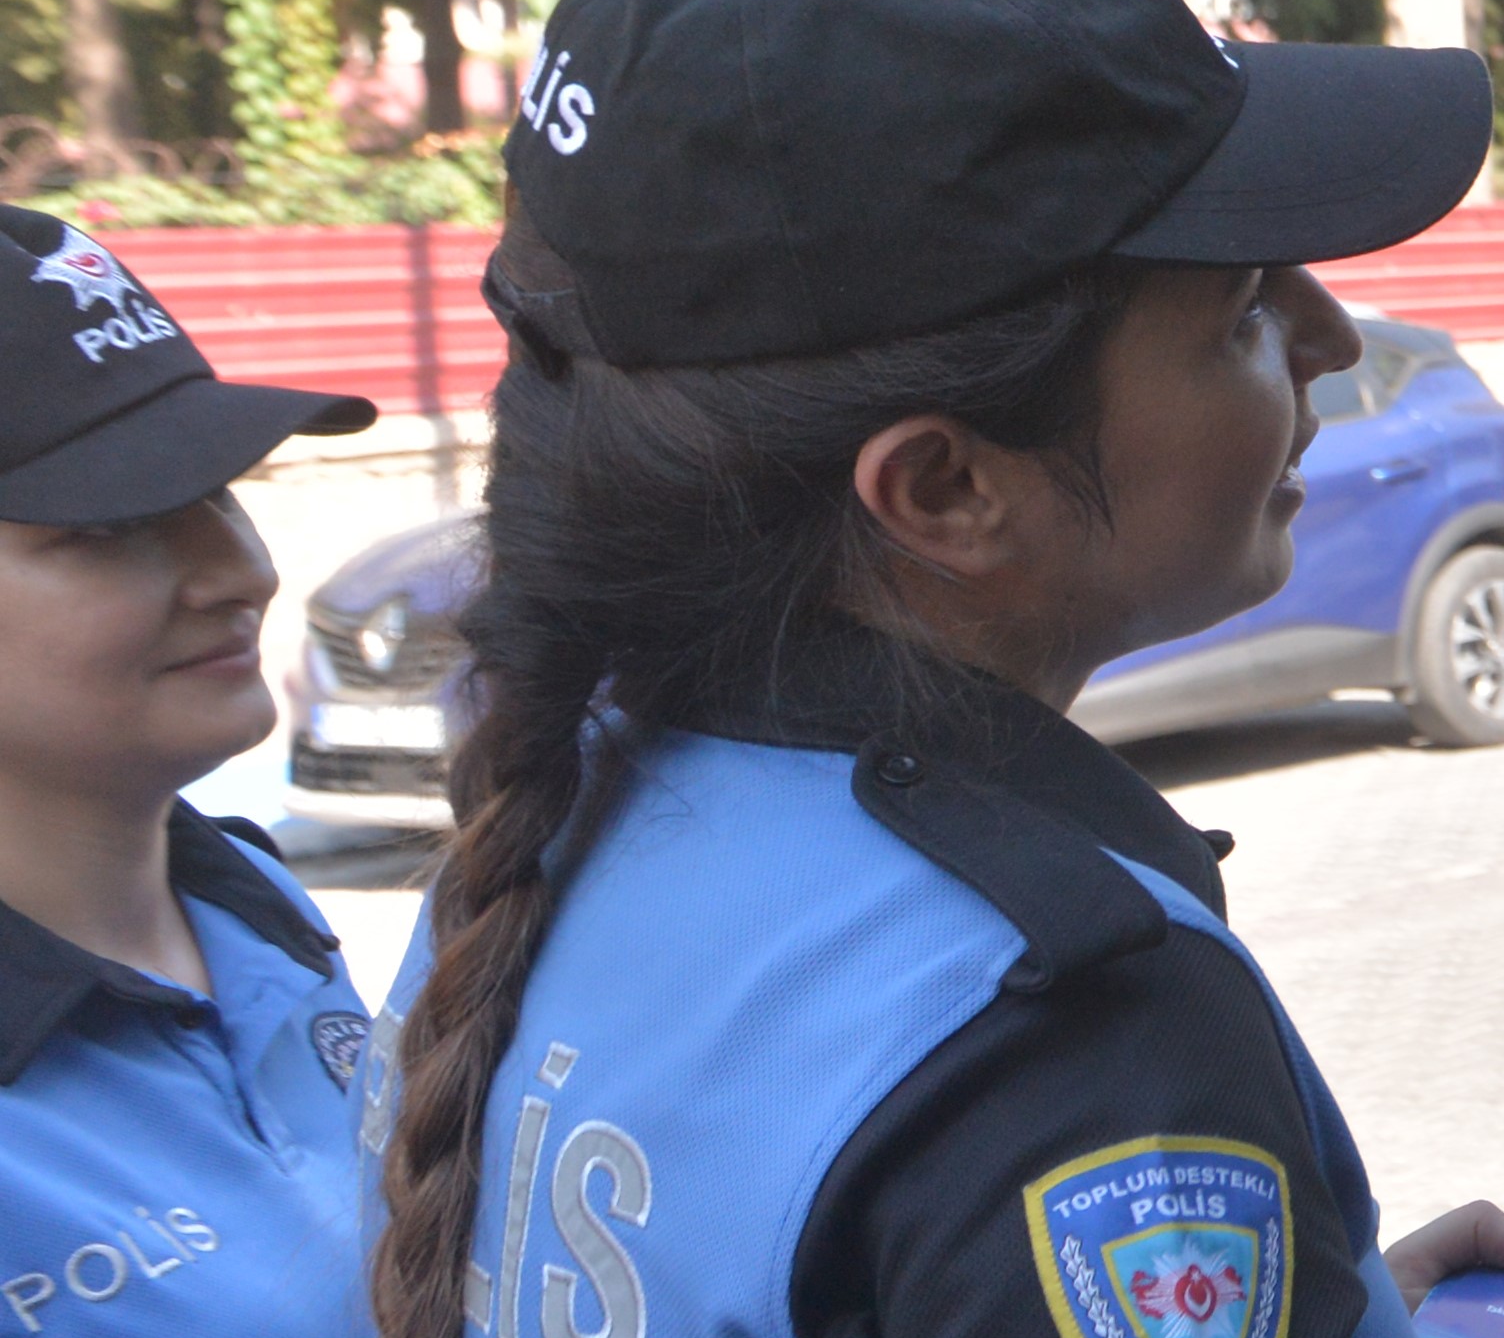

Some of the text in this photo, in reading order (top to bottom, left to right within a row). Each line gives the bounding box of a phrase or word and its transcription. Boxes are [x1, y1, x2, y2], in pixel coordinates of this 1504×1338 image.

[72, 297, 177, 363] POLİS
[1053, 1165, 1277, 1218] TOPLUM DESTEKLİ
[1130, 1188, 1227, 1225] POLİS
[2, 1206, 220, 1333] POLİS
